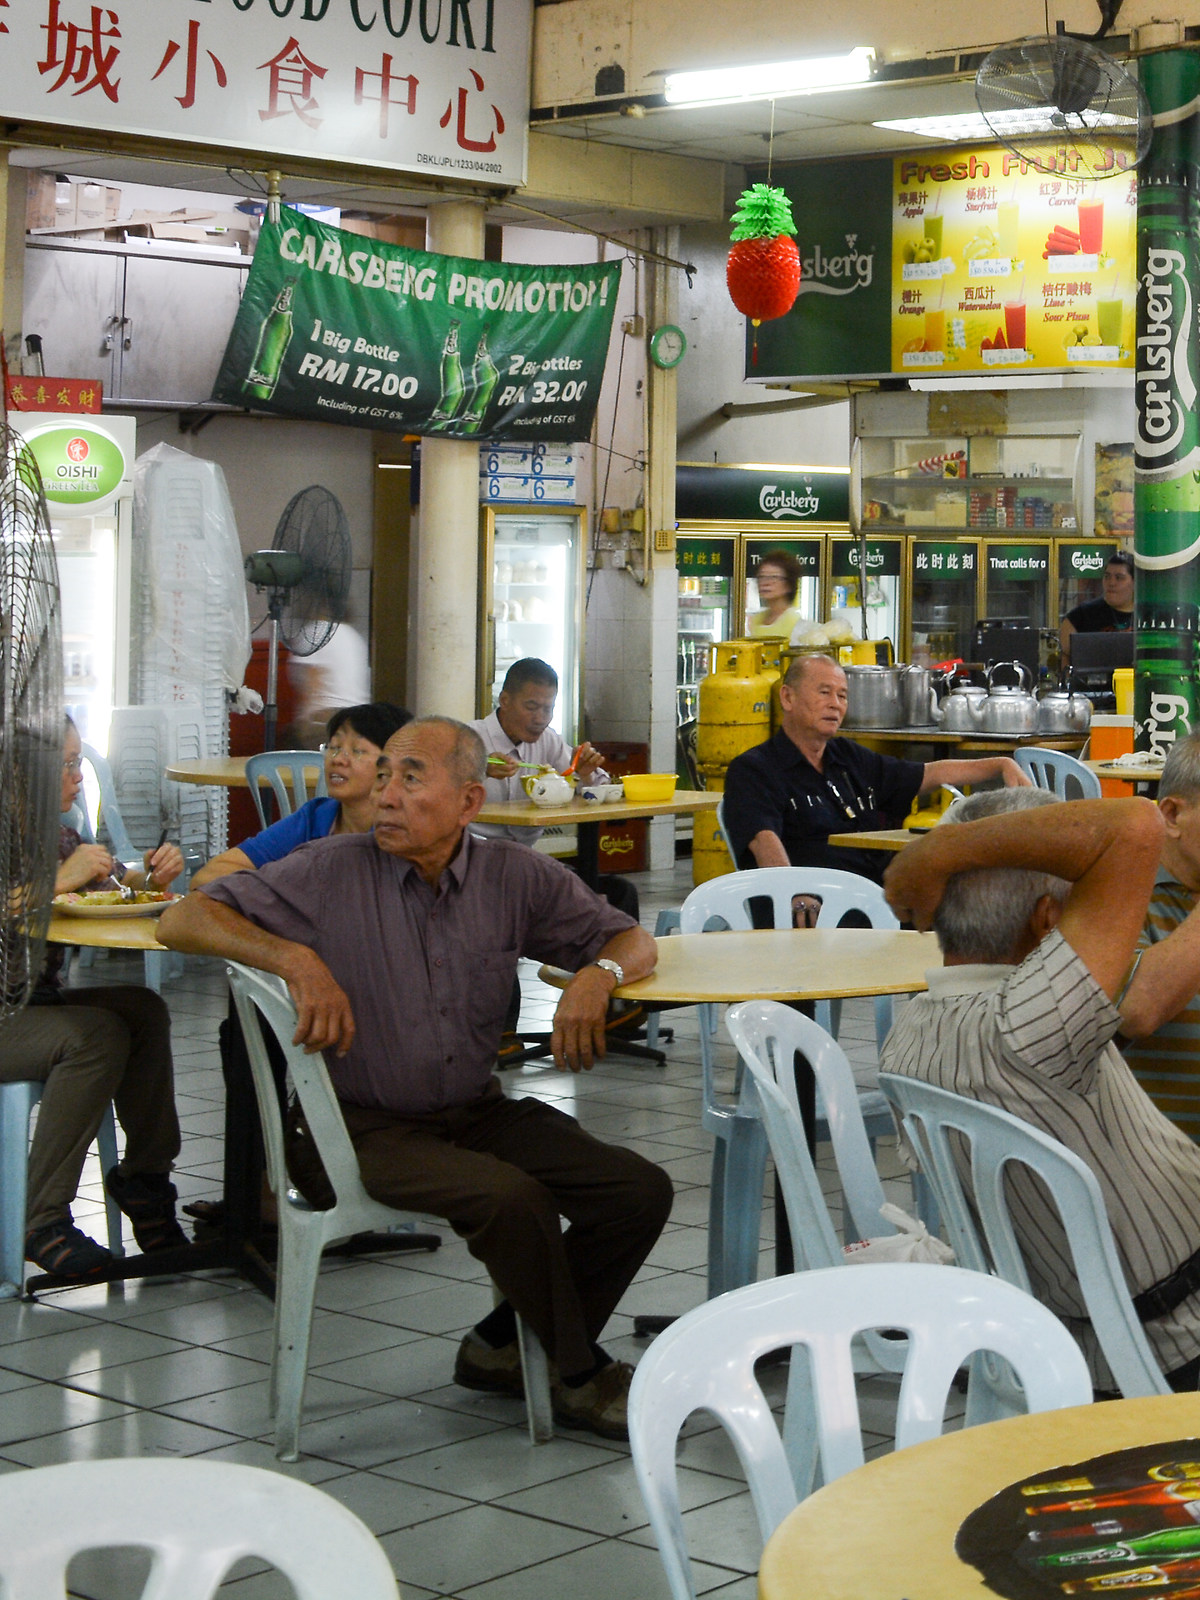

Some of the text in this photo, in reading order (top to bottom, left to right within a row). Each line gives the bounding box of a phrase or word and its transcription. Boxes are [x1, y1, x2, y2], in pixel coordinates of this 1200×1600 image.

[0, 0, 505, 153] 城小食中心
[901, 155, 990, 184] Fresh
[1002, 149, 1083, 177] Fruit
[1048, 196, 1077, 207] Carrot
[800, 244, 874, 287] sberg
[964, 286, 996, 300] 西瓜汁
[899, 305, 925, 315] Orange
[958, 301, 1002, 312] Watermelon
[1043, 312, 1090, 322] Sour Plum
[310, 319, 400, 363] 1 Big Bottle
[1136, 247, 1187, 458] Carlsberg
[298, 352, 350, 386] RM
[352, 365, 419, 400] 17.00
[508, 355, 525, 376] 2
[541, 356, 583, 371] ottles
[531, 380, 588, 404] 32.00
[317, 395, 358, 414] Including
[359, 405, 369, 416] of
[370, 407, 388, 419] GST
[57, 465, 98, 479] OISHI
[487, 453, 499, 474] 6
[531, 455, 544, 476] 6
[489, 476, 500, 498] 6
[533, 479, 545, 500] 6
[759, 484, 820, 514] Carlsberg
[849, 548, 884, 567] Casberg
[916, 553, 974, 570] 此时此刻
[990, 557, 1009, 569] That
[1010, 557, 1027, 569] calls
[1028, 557, 1040, 569] for
[1071, 551, 1104, 568] Carlsberg
